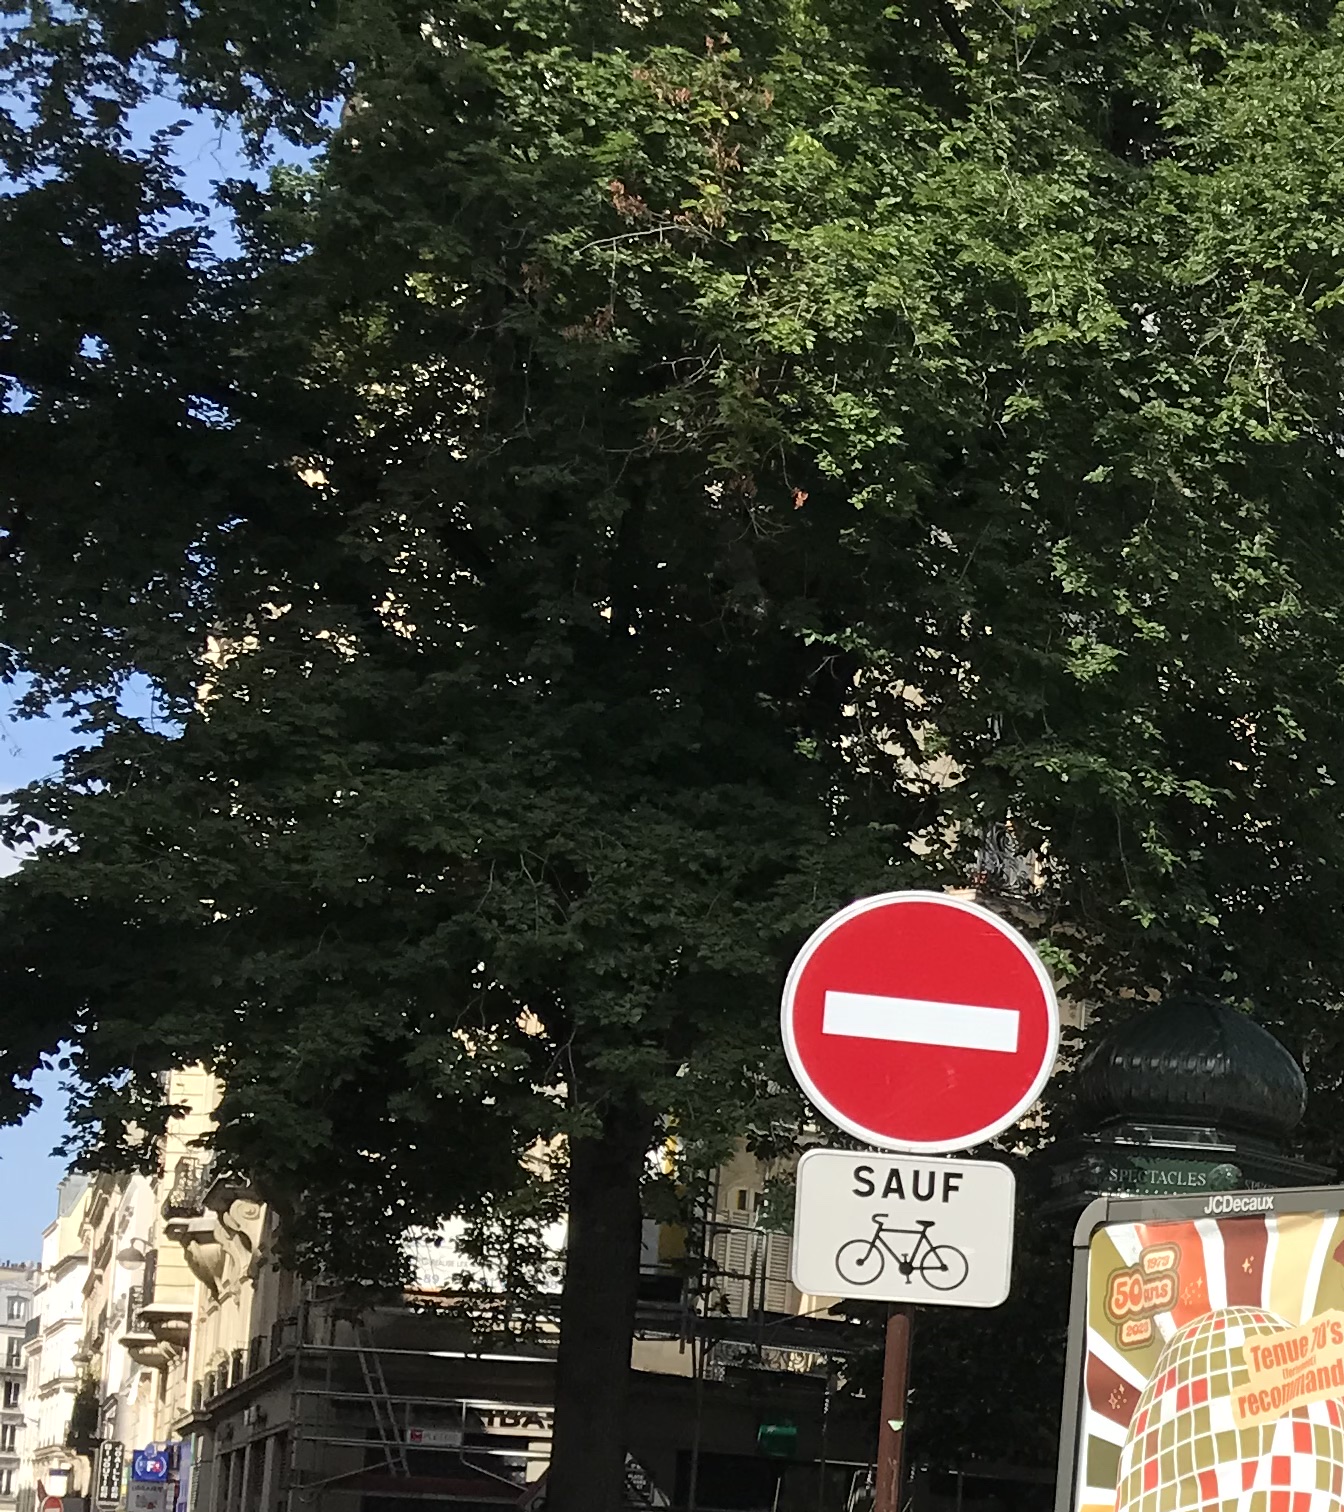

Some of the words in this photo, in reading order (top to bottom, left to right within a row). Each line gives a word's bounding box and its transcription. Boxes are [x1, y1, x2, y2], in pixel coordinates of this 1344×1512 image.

[851, 1165, 964, 1203] SAUF
[1108, 1168, 1207, 1186] SPECTACLES
[1203, 1195, 1274, 1215] JCDecaux
[1114, 1277, 1143, 1310] 50
[1250, 1335, 1309, 1373] Tenue
[1311, 1319, 1344, 1353] 70's
